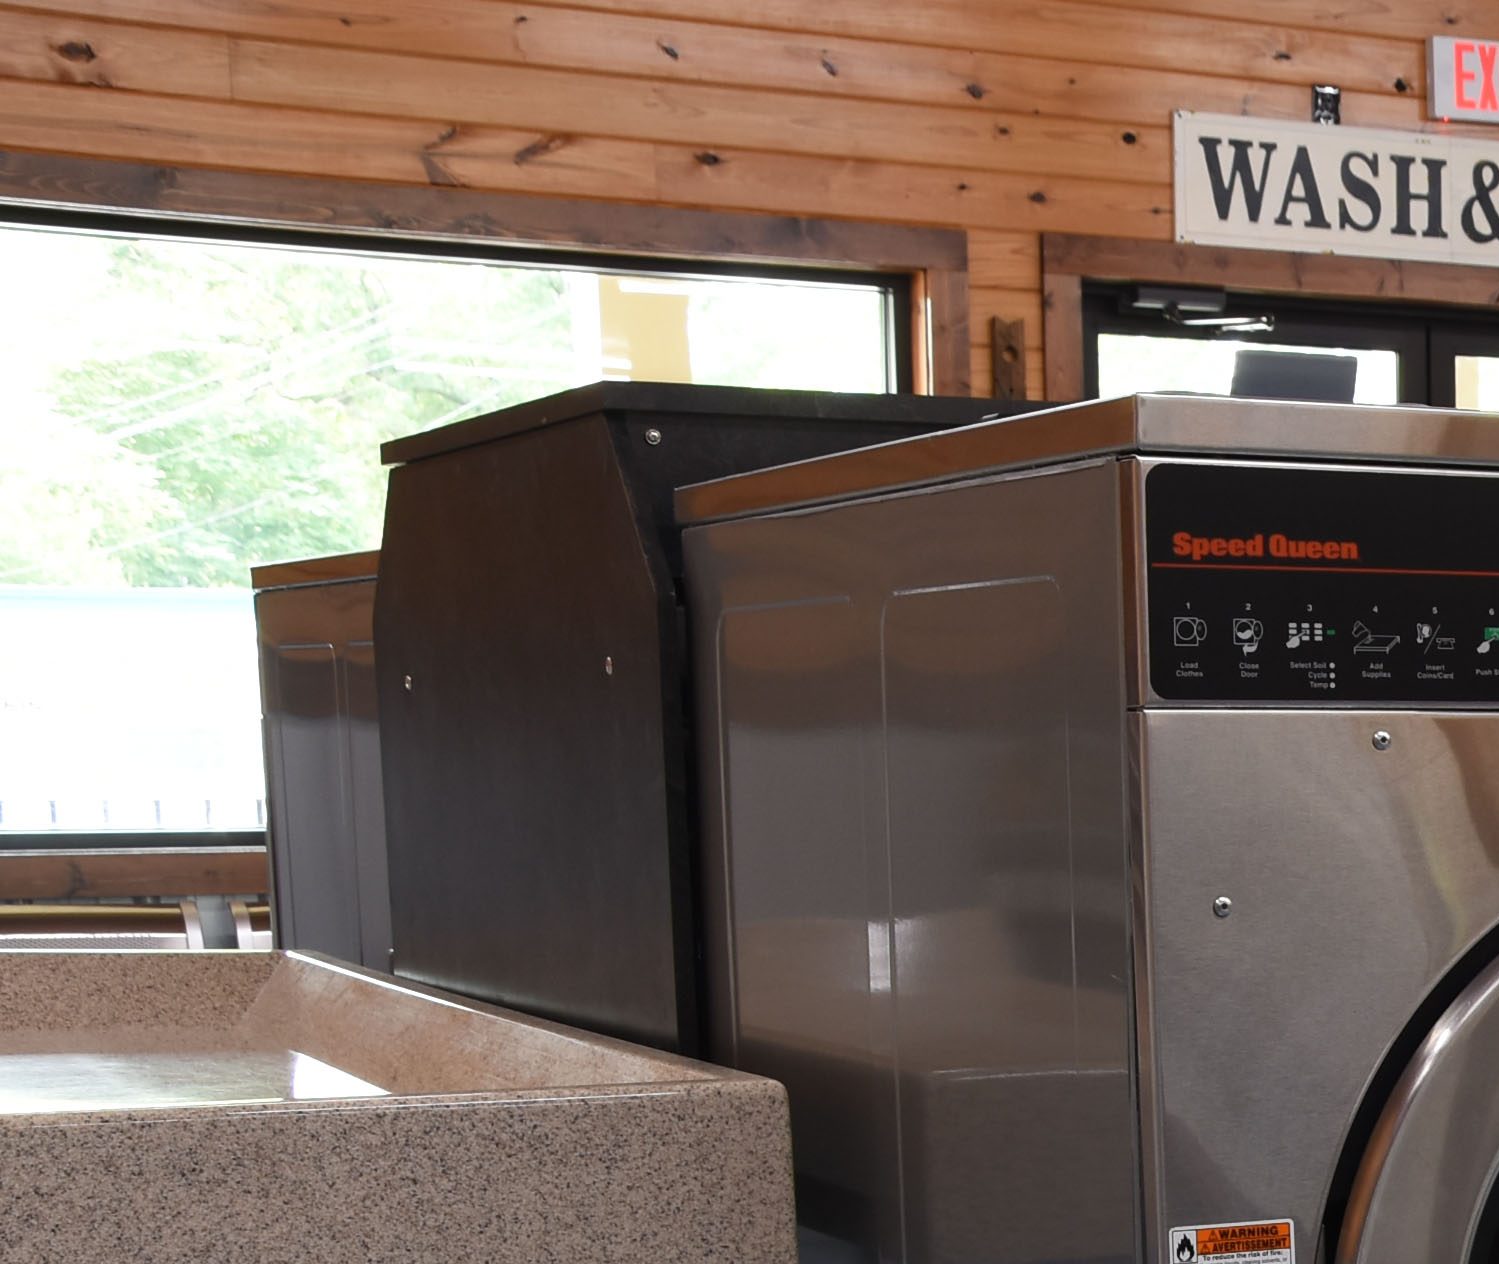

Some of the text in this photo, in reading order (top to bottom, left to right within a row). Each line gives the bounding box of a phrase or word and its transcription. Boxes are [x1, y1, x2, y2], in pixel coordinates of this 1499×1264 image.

[1172, 531, 1359, 560] Speed Queen
[1307, 604, 1312, 612] 3
[1489, 608, 1495, 616] 6
[1369, 662, 1383, 670] Add
[1362, 670, 1391, 678] Supplies
[1475, 668, 1492, 676] Push
[1310, 681, 1328, 689] Temp
[1220, 1226, 1278, 1238] WARNING
[1212, 1238, 1287, 1252] AVERTISSEMENT
